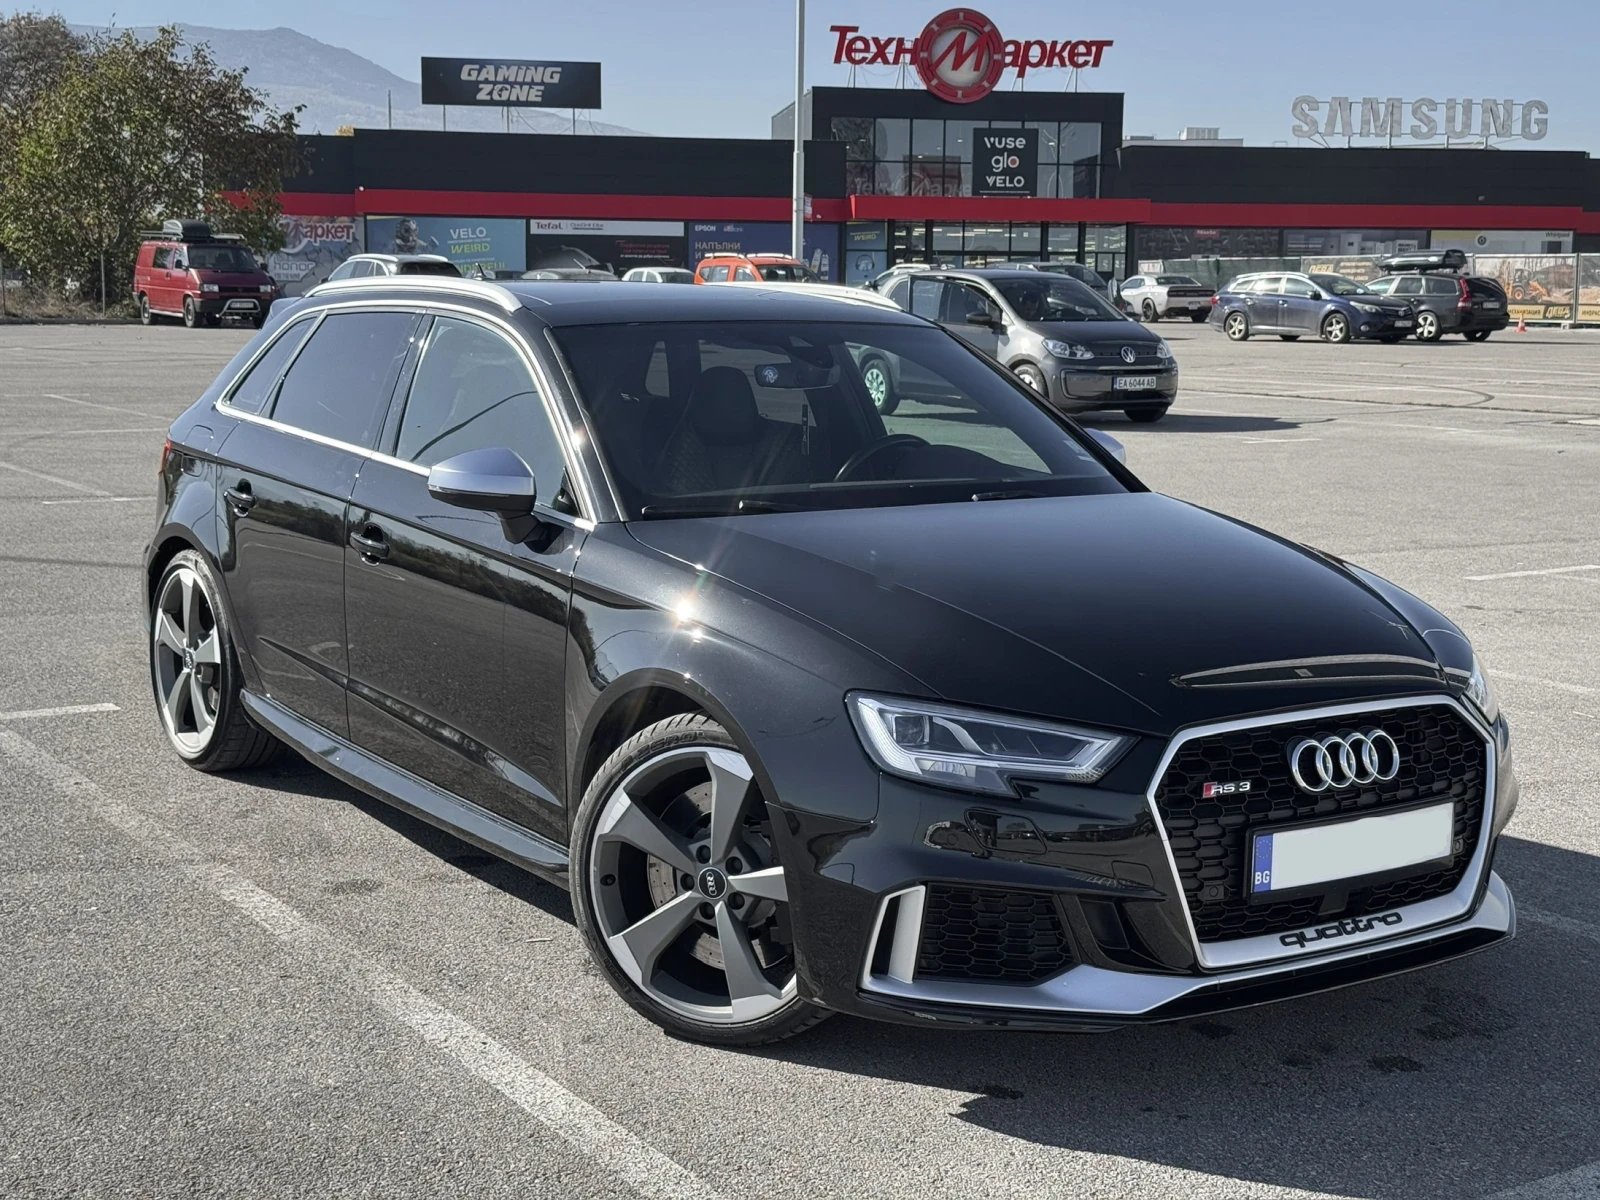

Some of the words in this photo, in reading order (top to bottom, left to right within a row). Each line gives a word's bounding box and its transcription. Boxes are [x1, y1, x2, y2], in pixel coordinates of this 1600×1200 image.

[460, 64, 562, 83] GAMING
[475, 84, 545, 102] ZONE
[1291, 95, 1549, 141] SAMSUNG
[991, 151, 1020, 173] glo
[985, 175, 1025, 188] VELO
[535, 221, 564, 230] Tefal
[694, 224, 717, 232] EPSON
[449, 226, 487, 239] VELO
[854, 233, 877, 241] WEIRD
[450, 242, 491, 254] WEIRD
[694, 241, 741, 250] НАПЪЛНИ
[273, 257, 315, 271] honor
[1118, 378, 1128, 388] EA
[1128, 378, 1146, 388] 6044
[1146, 377, 1155, 387] AB
[1211, 783, 1236, 795] RS
[1255, 870, 1271, 884] BG
[1278, 912, 1403, 948] quattro
